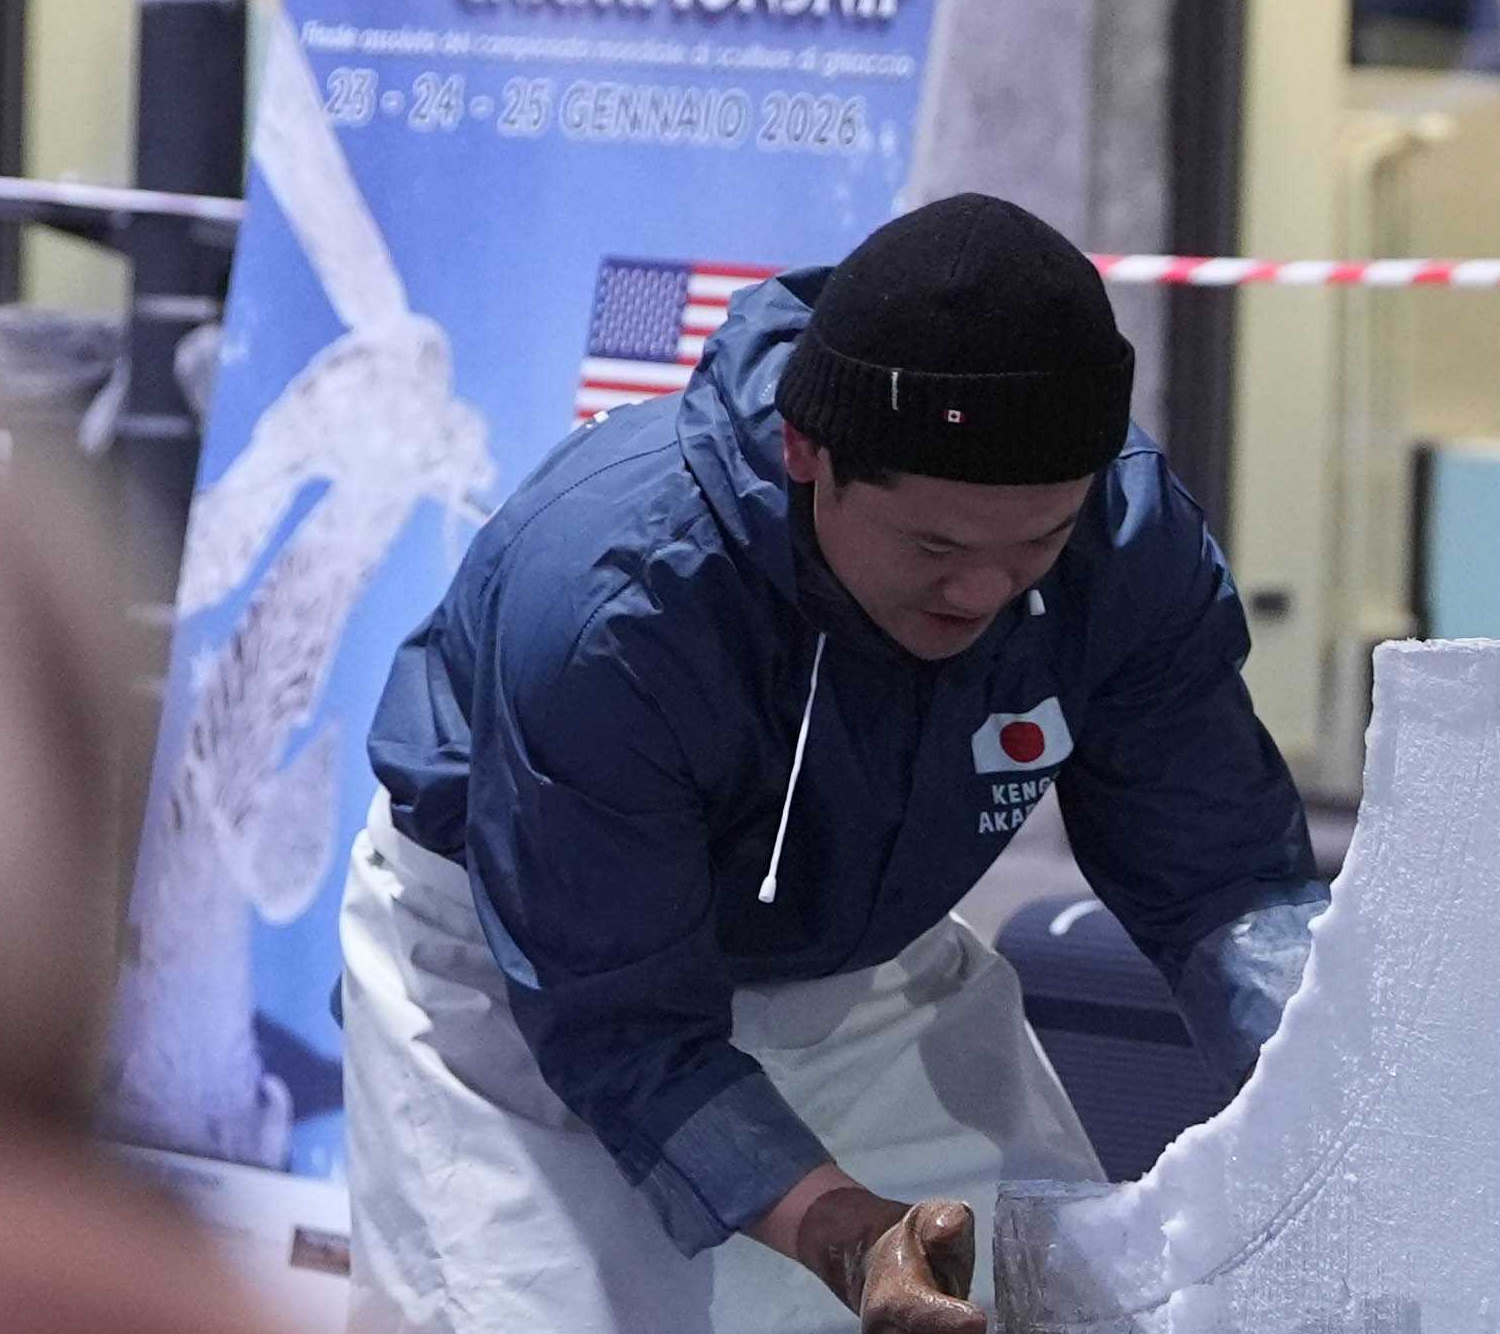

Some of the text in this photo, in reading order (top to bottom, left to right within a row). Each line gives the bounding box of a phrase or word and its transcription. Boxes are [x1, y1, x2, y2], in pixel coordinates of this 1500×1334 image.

[326, 67, 378, 127] 23
[409, 71, 465, 131] 24
[498, 75, 552, 136] 25
[559, 77, 750, 149] GENNAIO
[757, 90, 866, 151] 2026
